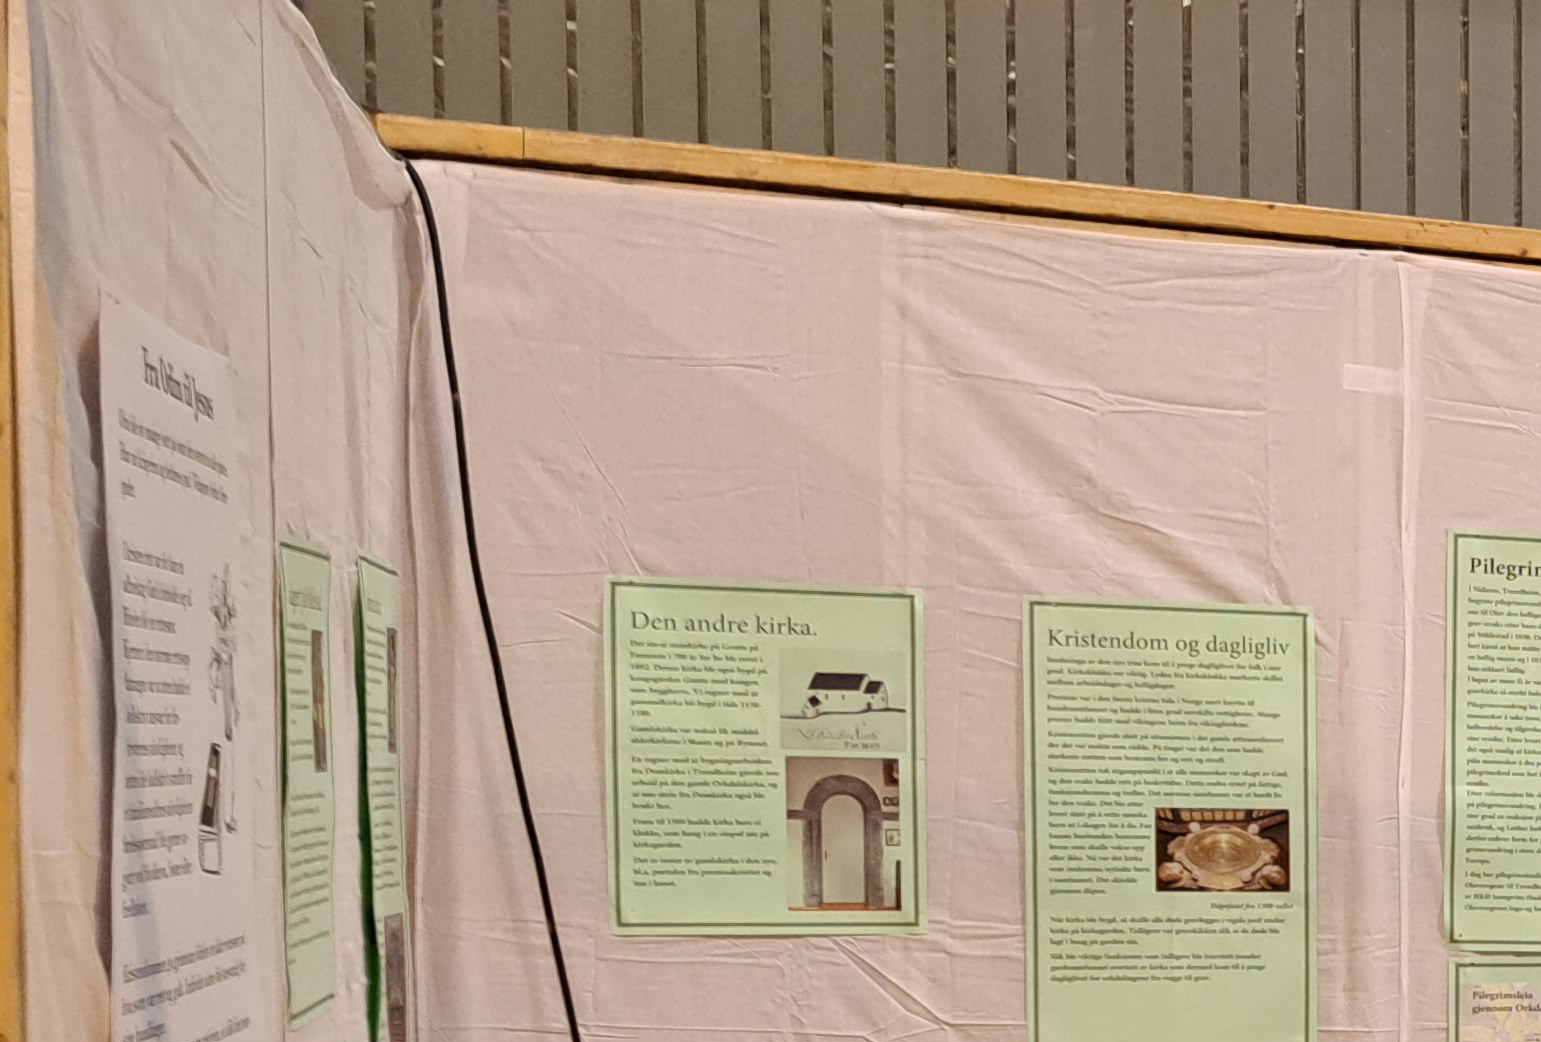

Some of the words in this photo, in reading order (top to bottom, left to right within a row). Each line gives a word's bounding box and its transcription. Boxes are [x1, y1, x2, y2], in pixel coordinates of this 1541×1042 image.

[631, 611, 677, 631] Den
[684, 613, 749, 635] andre
[755, 615, 818, 637] kirka.
[1048, 628, 1169, 653] Kristendom
[1175, 638, 1200, 656] og
[1206, 634, 1291, 658] dagligliv
